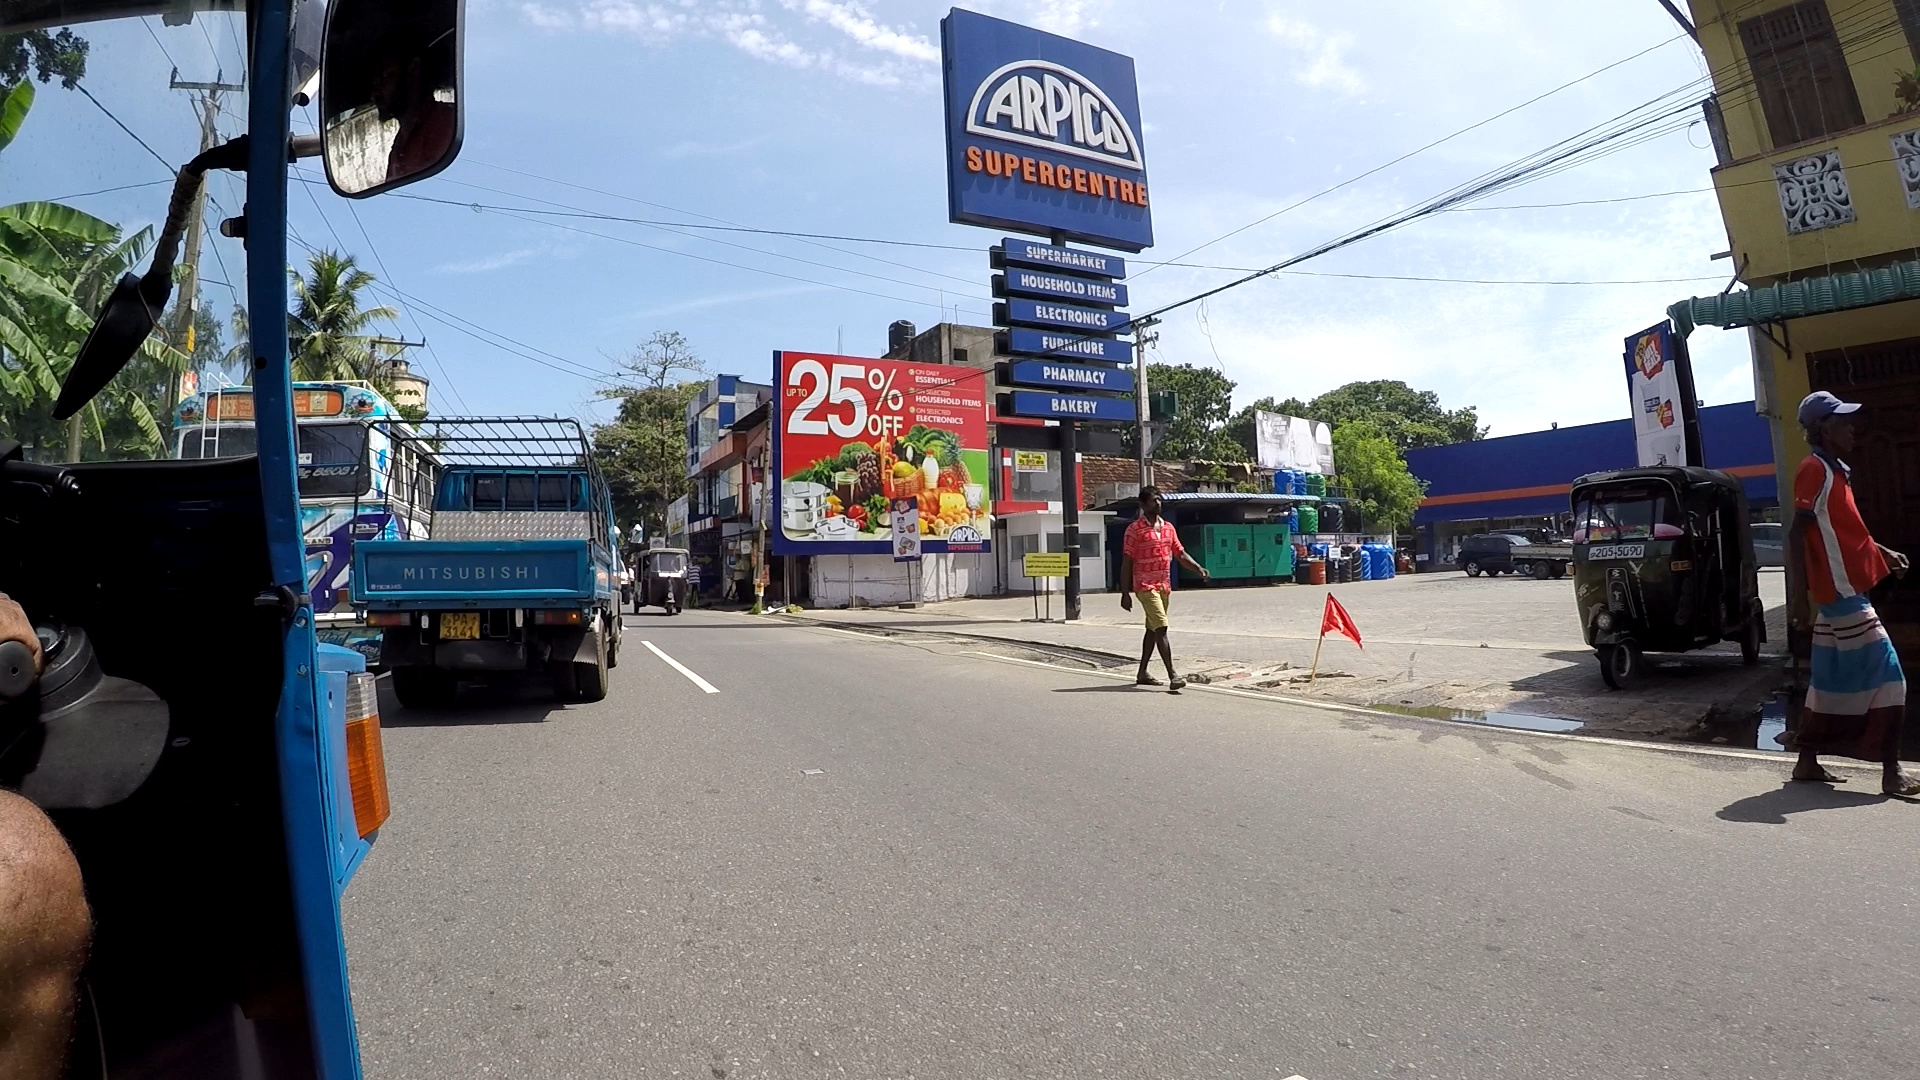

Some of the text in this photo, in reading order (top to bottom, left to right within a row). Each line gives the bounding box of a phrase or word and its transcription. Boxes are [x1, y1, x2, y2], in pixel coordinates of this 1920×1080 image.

[985, 73, 1129, 154] ARPICO
[966, 145, 1148, 208] SUPERCENTRE
[1026, 245, 1107, 270] SUPERMARKET
[1020, 274, 1117, 300] HOUSEHOLD ITEMS
[1035, 305, 1108, 327] ELECTRONICS
[1042, 336, 1105, 355] FURNITURE
[915, 376, 956, 386] ESSENTIALS
[1043, 366, 1106, 385] PHARMACY
[786, 388, 808, 398] UP TO
[787, 359, 904, 438] 25%
[915, 395, 982, 408] HOUSEHOLD ITEMS
[1051, 398, 1098, 414] BAKERY
[867, 414, 904, 437] OFF
[915, 414, 964, 425] ELECTRONICS
[950, 527, 980, 542] ARPICO
[1595, 545, 1643, 558] 205-5090
[403, 566, 539, 580] MITSUBISHI
[452, 613, 468, 625] PA
[444, 626, 475, 638] 3141
